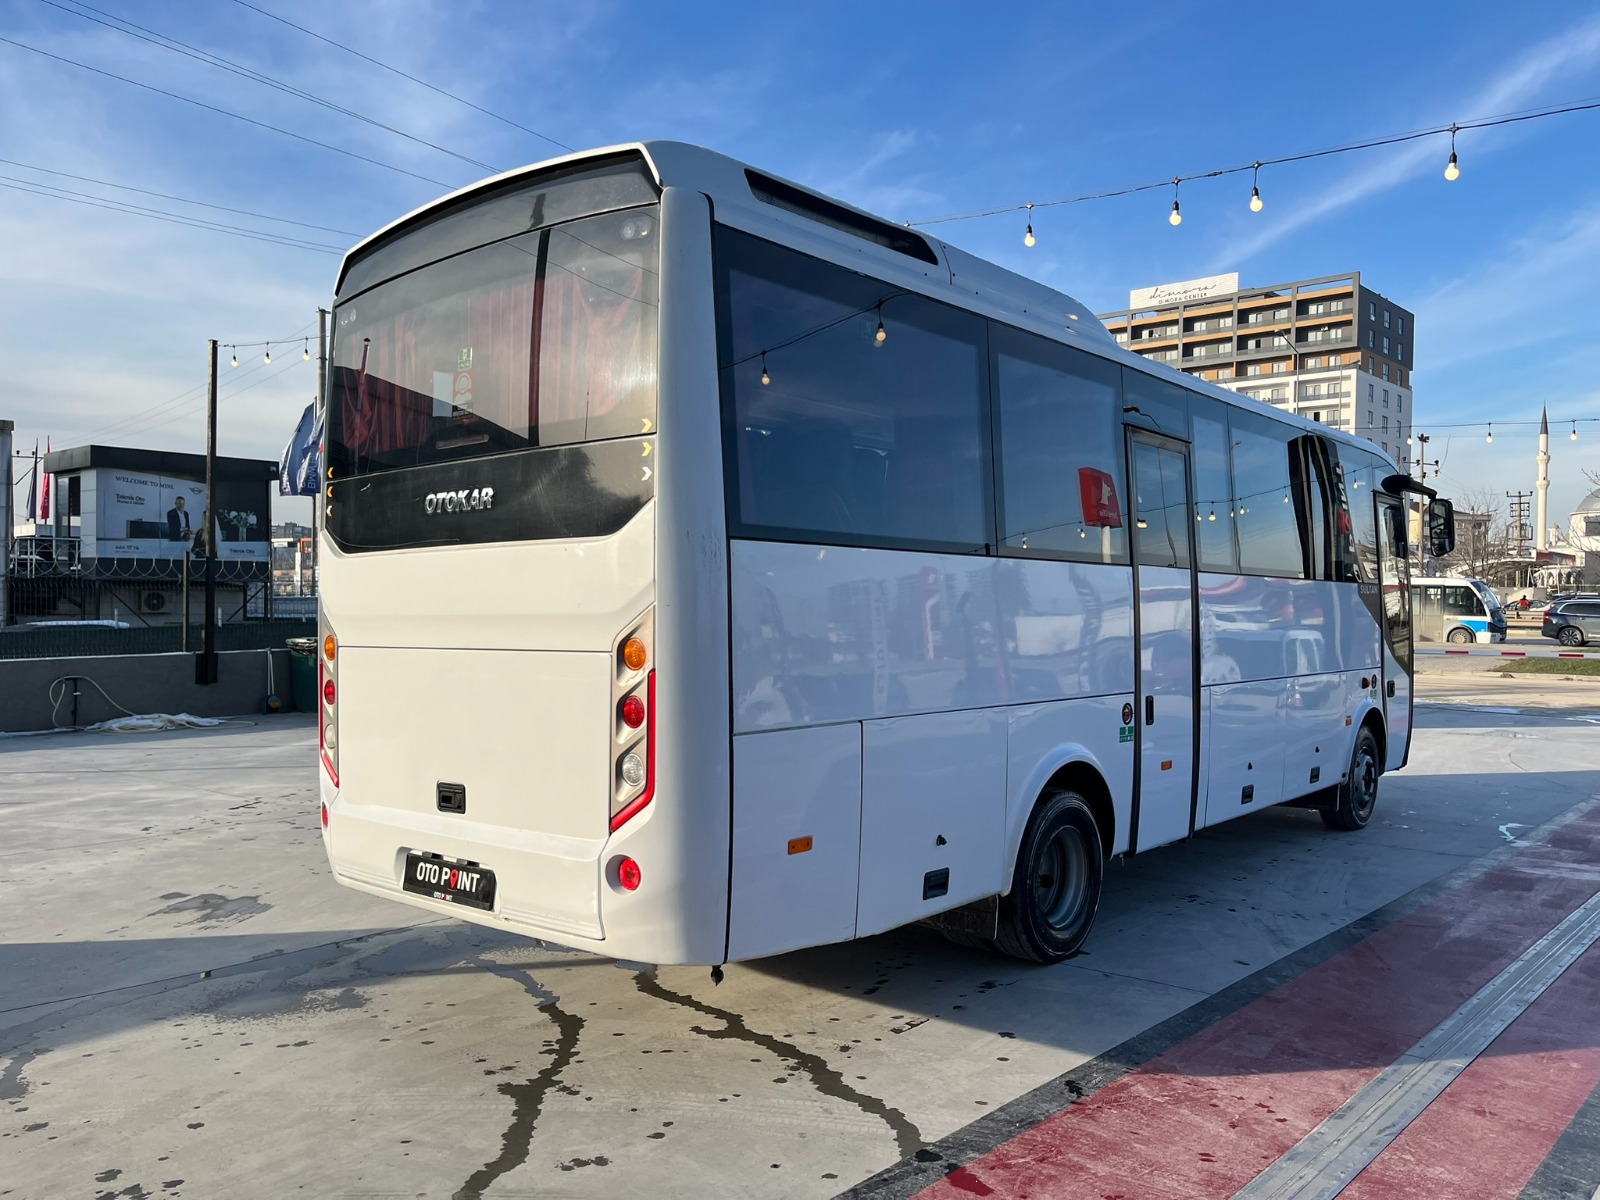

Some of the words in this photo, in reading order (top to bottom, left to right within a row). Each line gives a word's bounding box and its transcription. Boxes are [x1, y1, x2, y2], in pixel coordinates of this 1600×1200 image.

[1184, 293, 1207, 301] CENTER
[115, 475, 149, 486] WELCOME
[424, 487, 494, 514] OTOKAR
[1359, 585, 1378, 594] SULTAN
[416, 862, 439, 884] OTO
